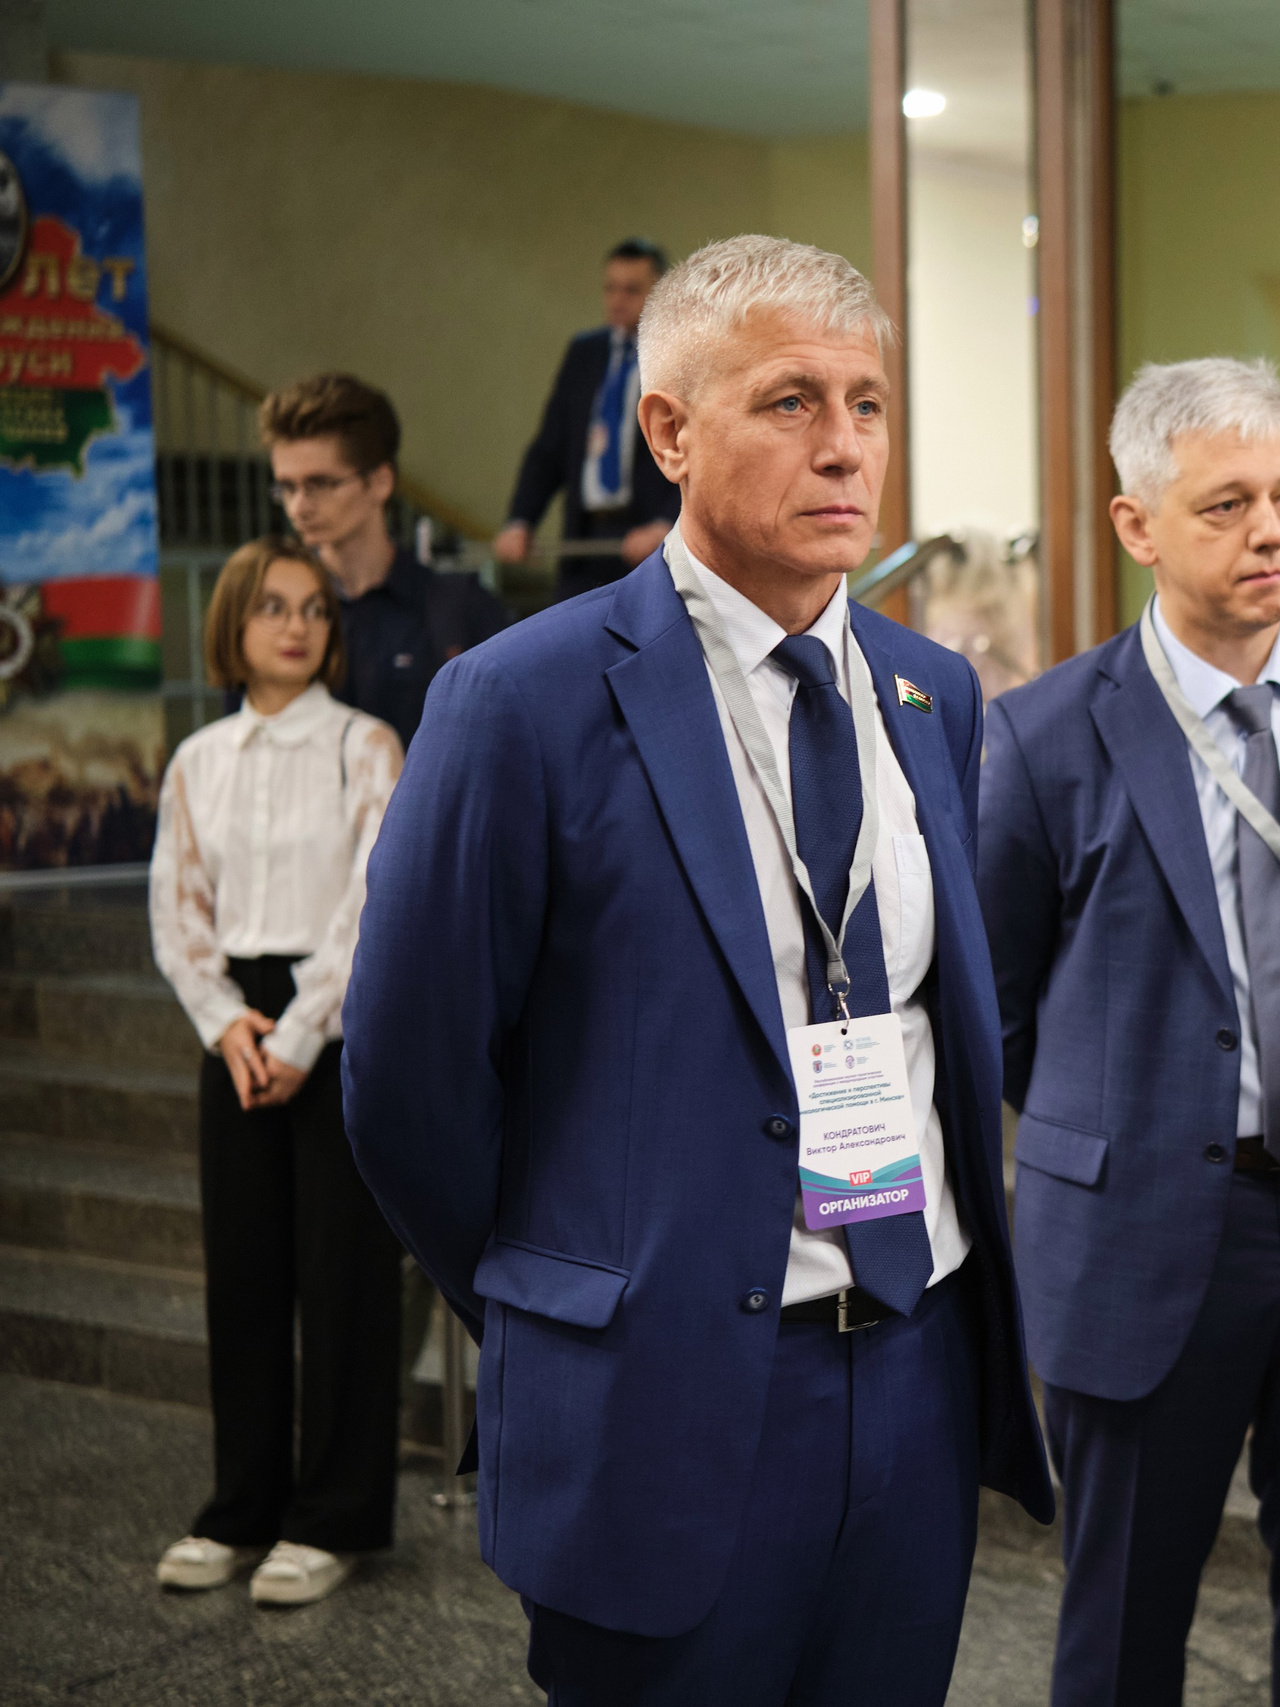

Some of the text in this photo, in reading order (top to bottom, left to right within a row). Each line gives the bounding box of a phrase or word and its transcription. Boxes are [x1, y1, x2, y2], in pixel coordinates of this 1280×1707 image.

[852, 1082, 891, 1093] перспективы
[819, 1091, 881, 1105] специализированной
[823, 1123, 886, 1141] КОНДРАТОВИЧ
[806, 1134, 906, 1156] Виктор Александрович
[850, 1172, 871, 1185] VIP
[818, 1188, 909, 1215] ОРГАНИЗАТОР
